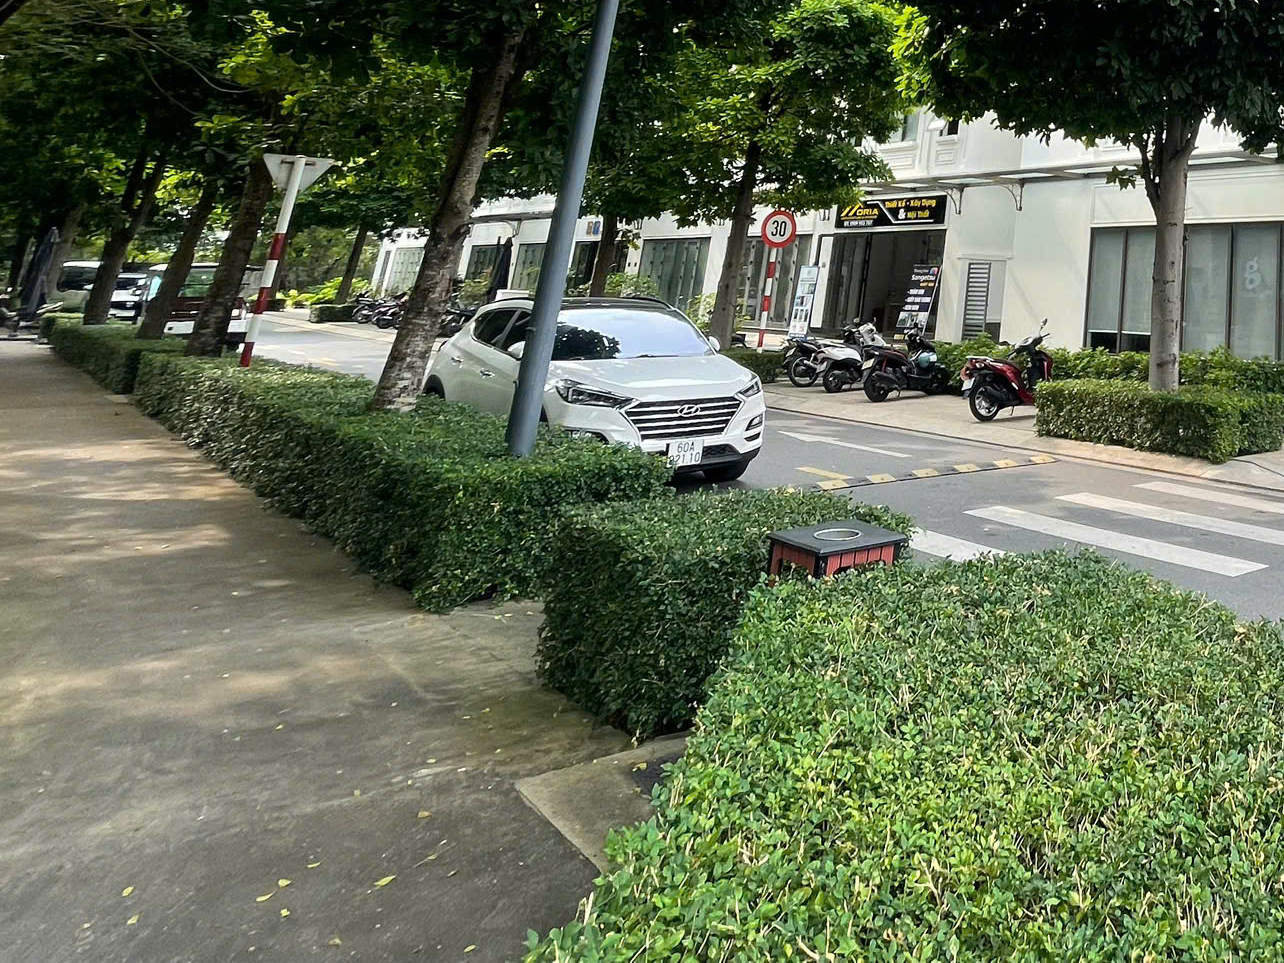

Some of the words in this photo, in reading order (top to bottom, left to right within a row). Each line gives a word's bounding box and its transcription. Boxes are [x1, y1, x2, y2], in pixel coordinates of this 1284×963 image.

[898, 208, 906, 219] &
[771, 220, 787, 237] 30
[677, 441, 695, 453] 60A
